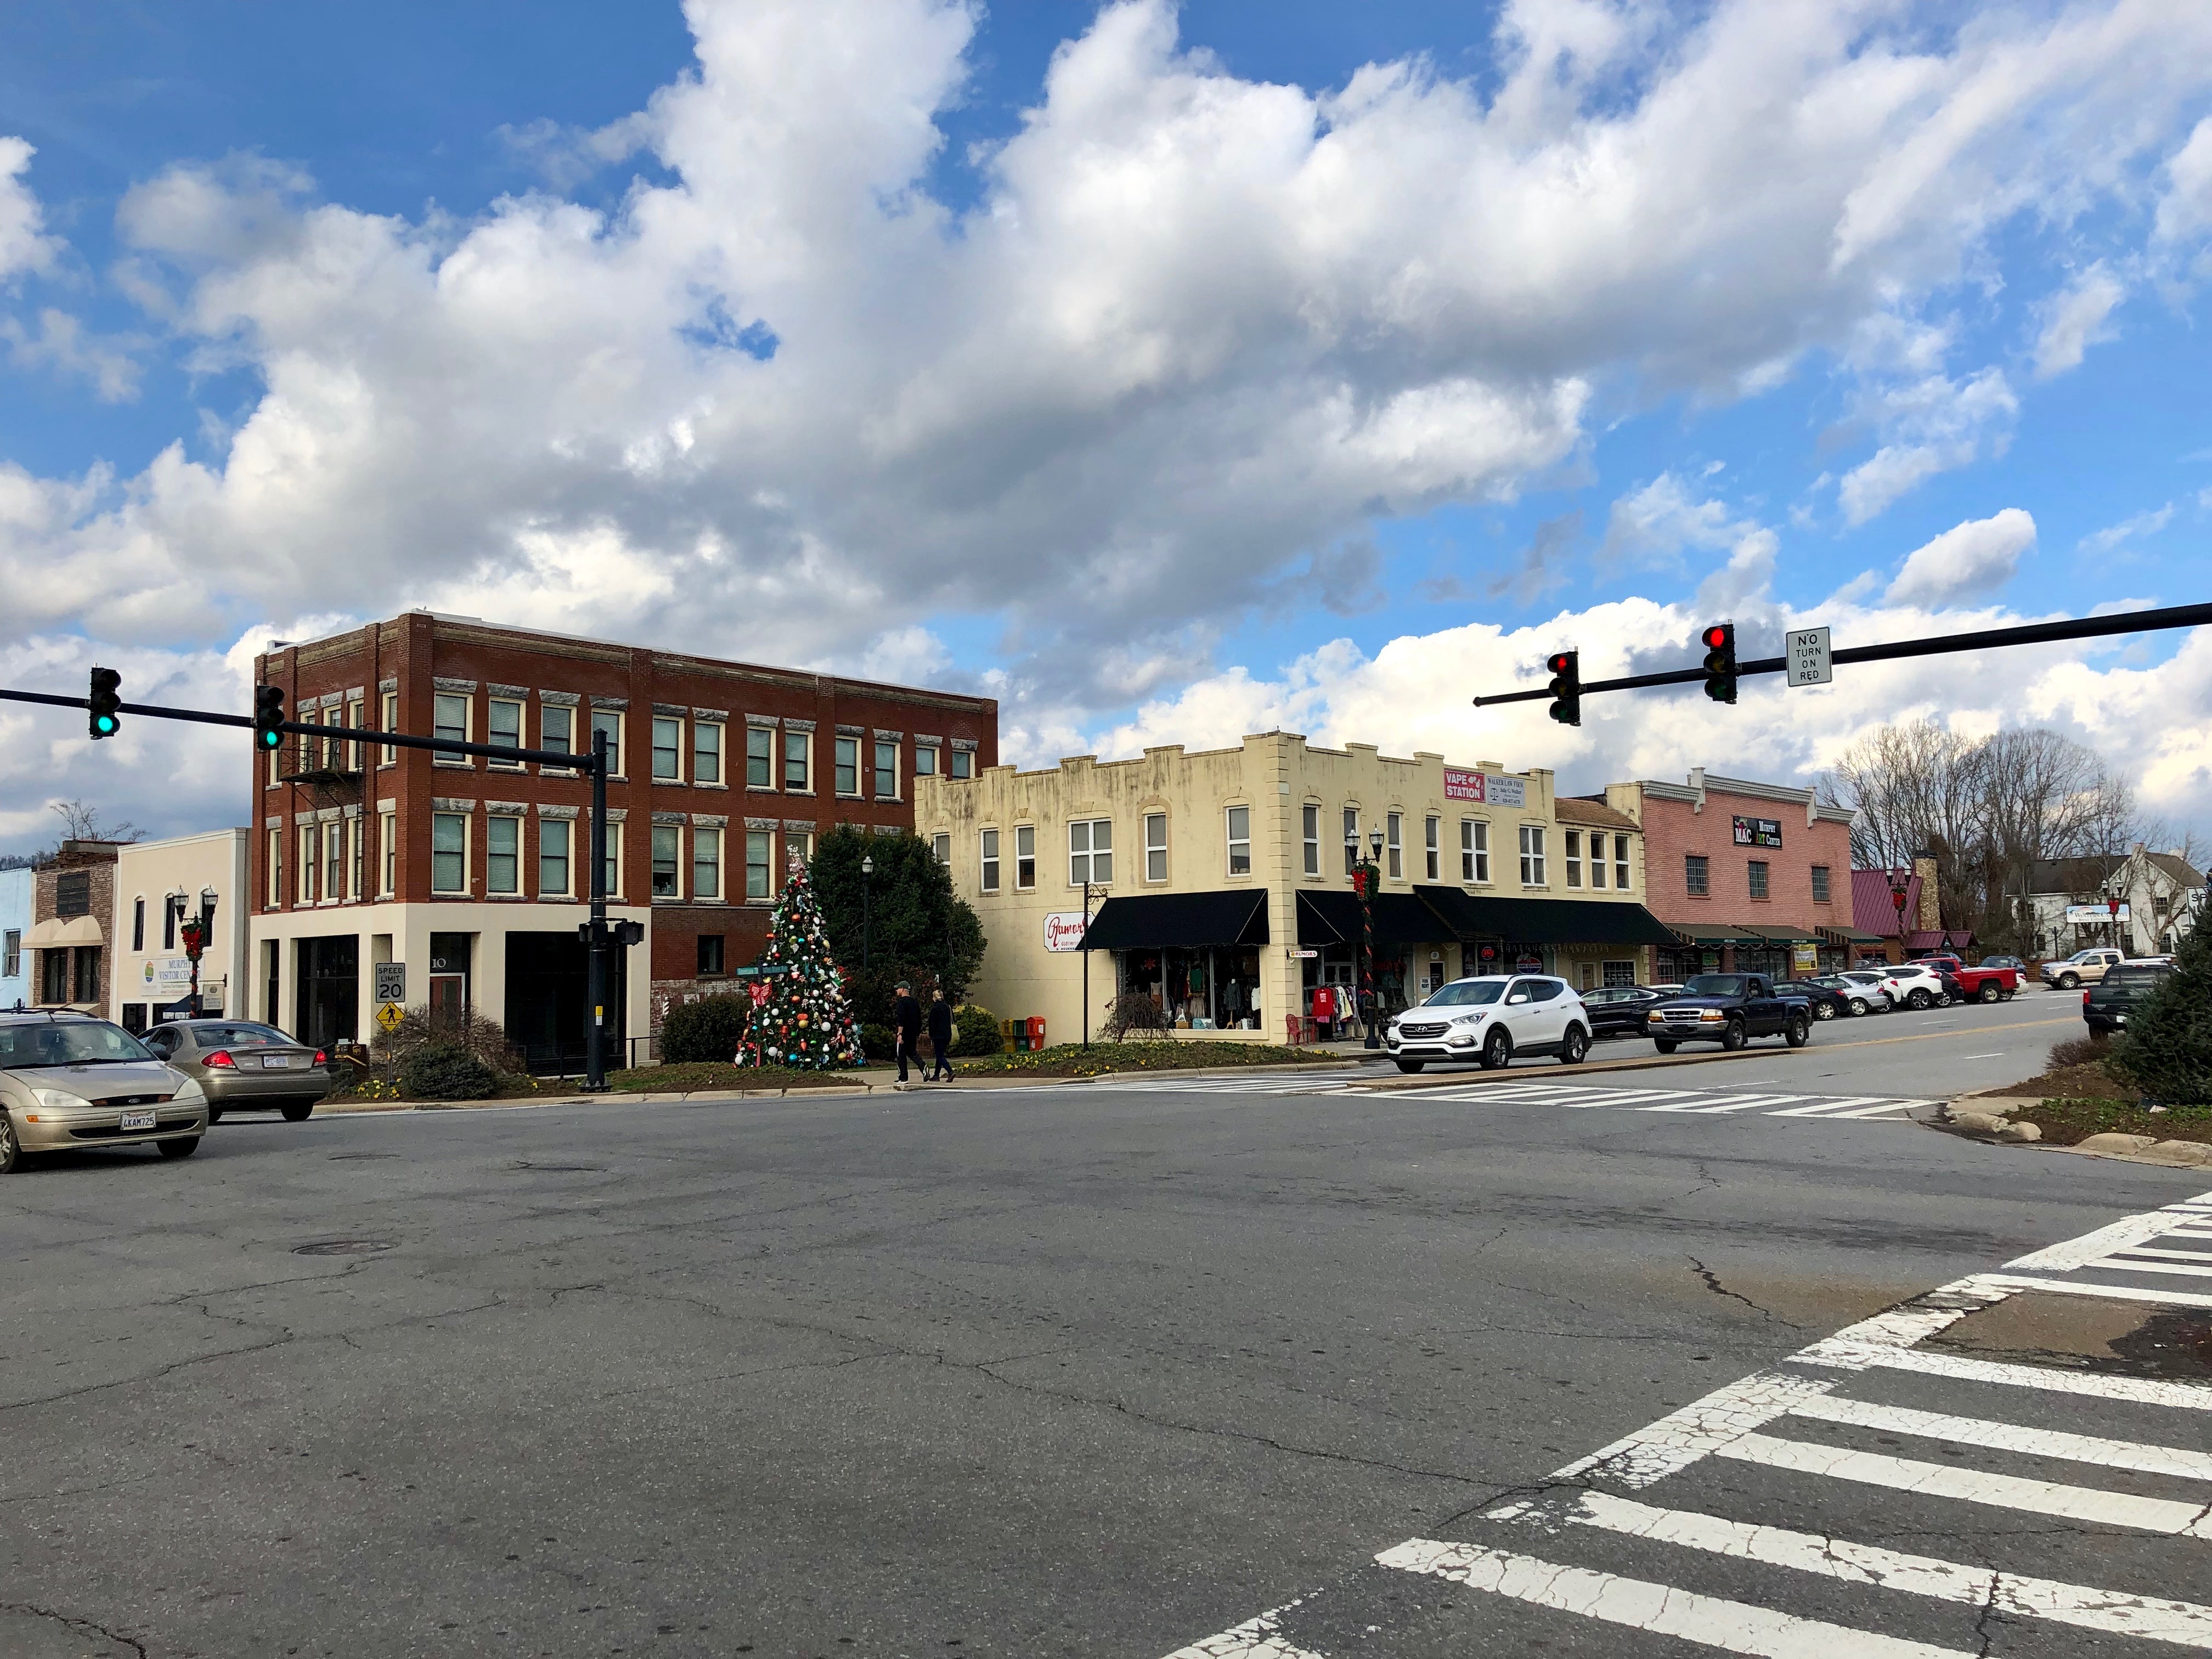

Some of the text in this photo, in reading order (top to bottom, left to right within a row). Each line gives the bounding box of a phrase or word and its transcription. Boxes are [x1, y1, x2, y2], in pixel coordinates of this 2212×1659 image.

[1798, 634, 1818, 646] NO
[1796, 647, 1821, 658] TURN
[1802, 659, 1816, 668] ON
[1800, 670, 1819, 680] RED
[1446, 772, 1468, 785] VAPE
[1487, 777, 1504, 786] WALKER
[1447, 785, 1480, 799] STATION
[1735, 828, 1752, 843] MAC
[431, 958, 447, 968] 10
[159, 970, 179, 980] VISITOR
[379, 984, 402, 998] 20
[123, 1117, 154, 1127] 4KAM725
